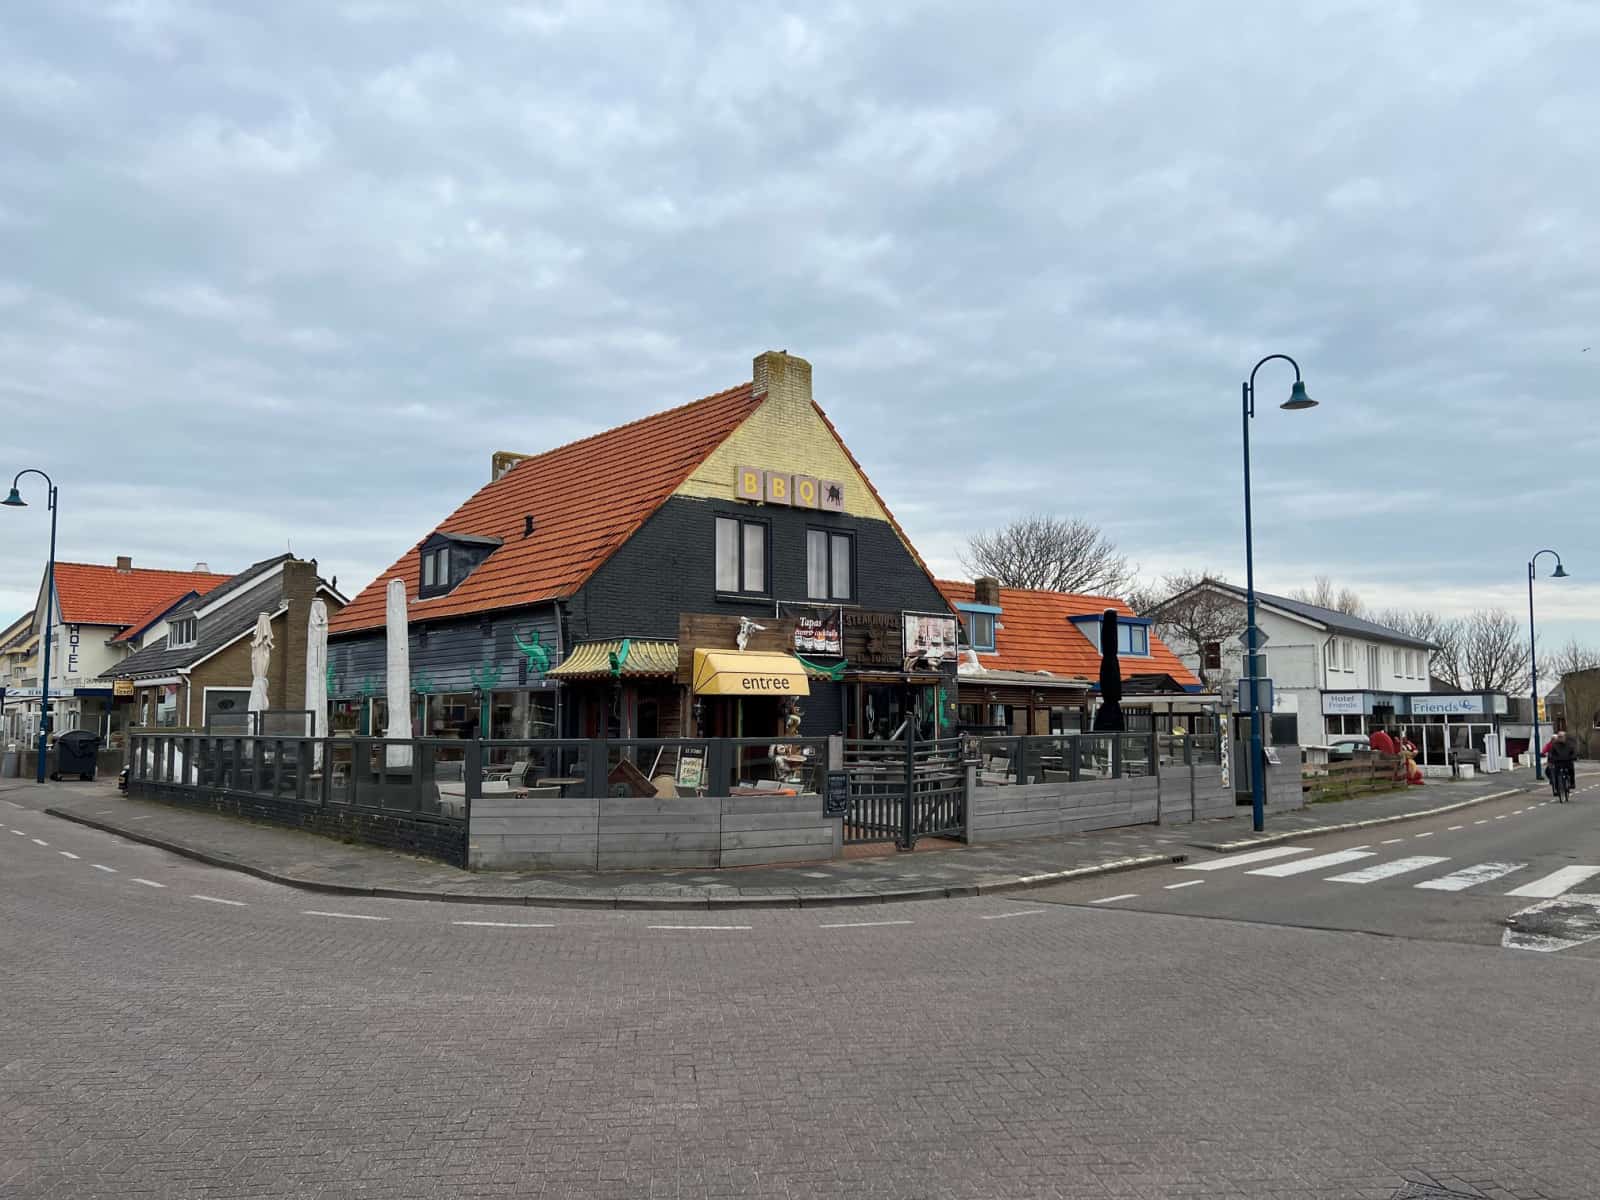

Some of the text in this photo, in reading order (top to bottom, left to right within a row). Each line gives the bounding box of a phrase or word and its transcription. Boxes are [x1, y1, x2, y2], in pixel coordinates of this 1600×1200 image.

[744, 472, 814, 507] BBQ
[800, 616, 822, 629] Tapas
[845, 614, 899, 626] STEAKHOUSE
[68, 624, 79, 672] HOTEL
[742, 677, 790, 690] entree
[1331, 695, 1354, 703] Hotel
[1413, 702, 1459, 713] Friends
